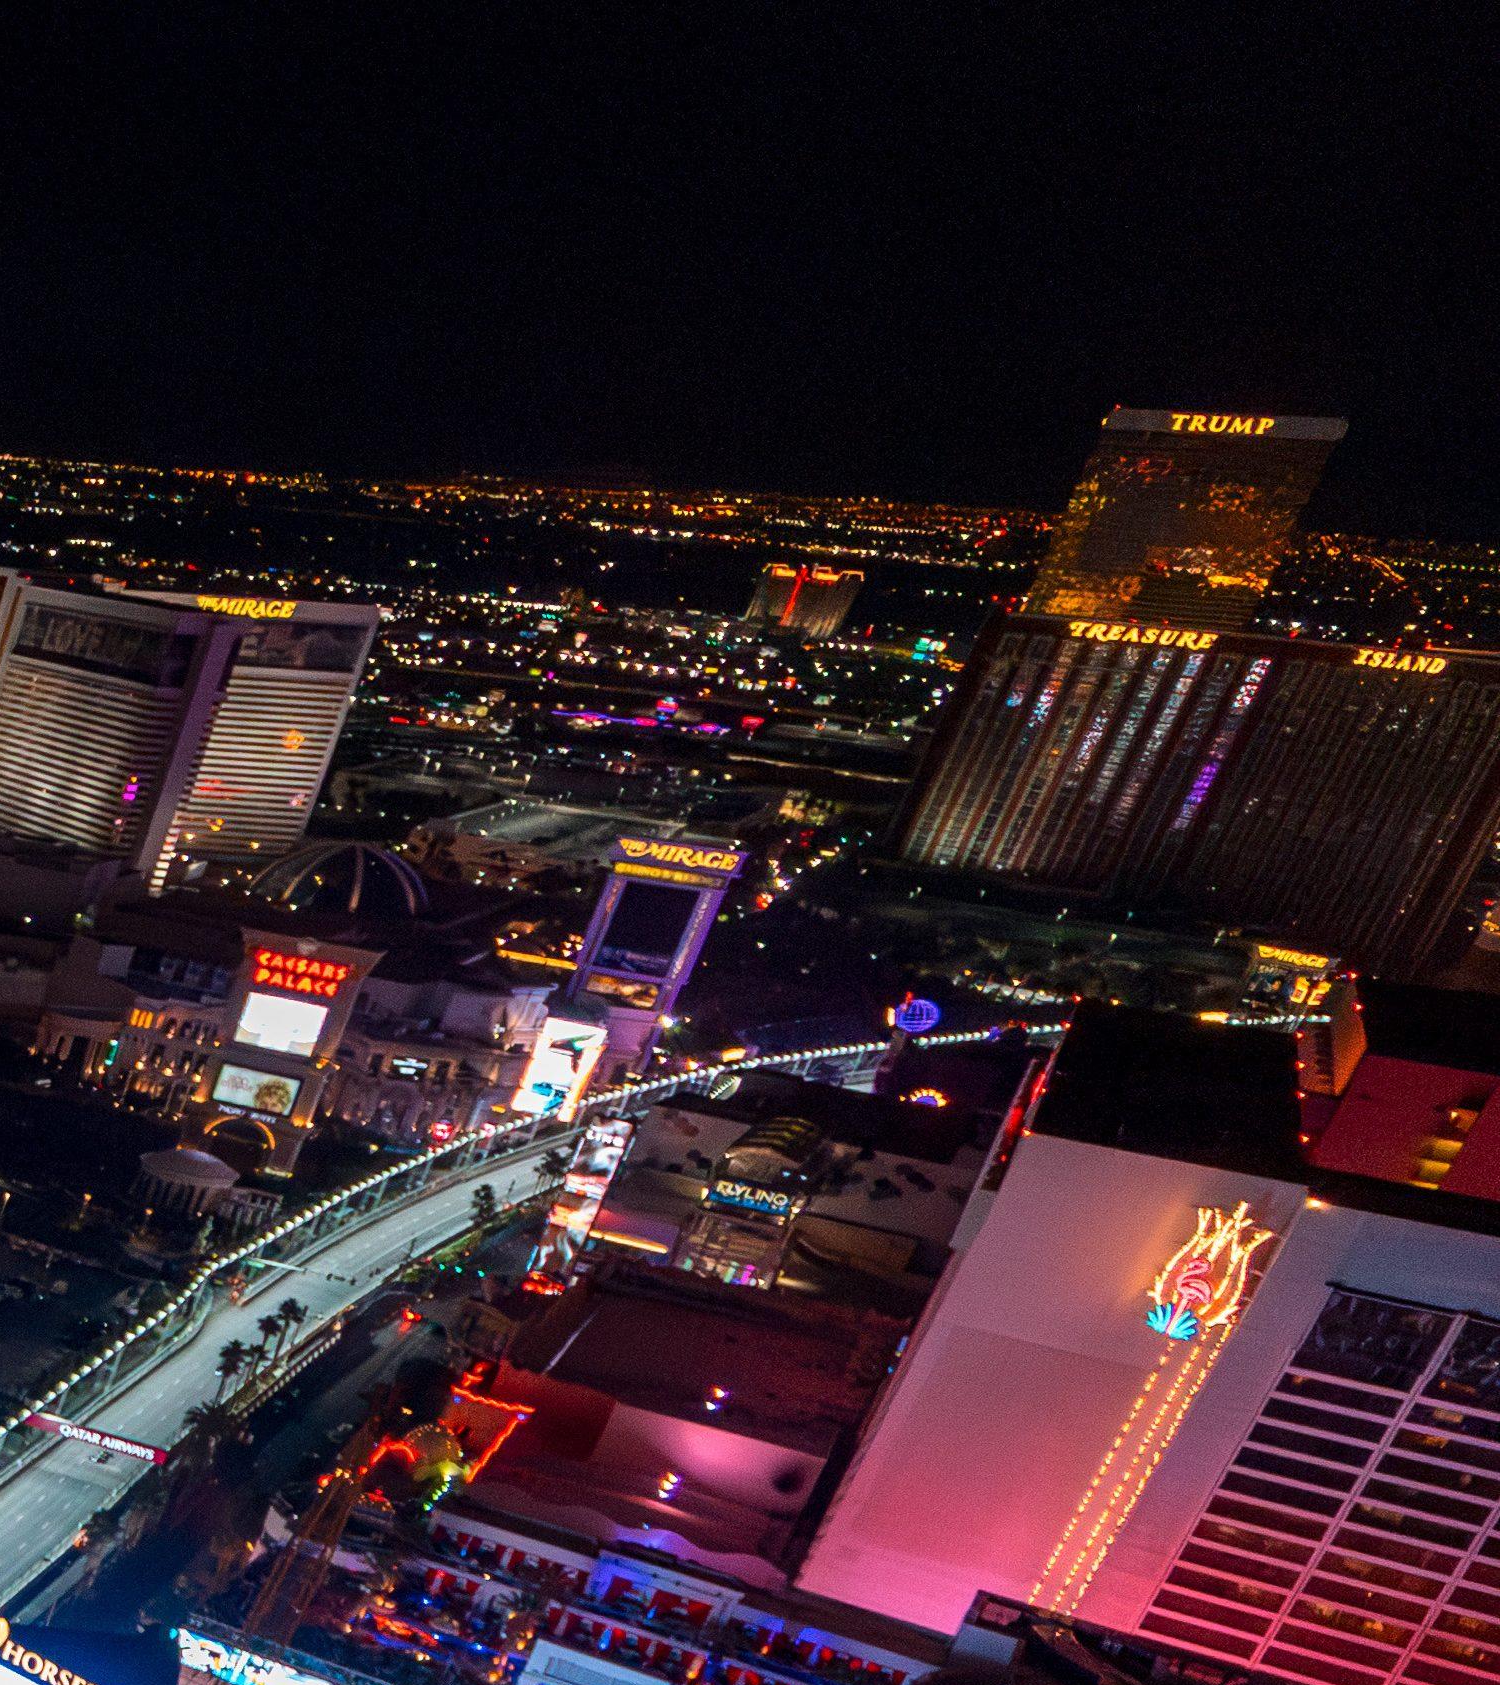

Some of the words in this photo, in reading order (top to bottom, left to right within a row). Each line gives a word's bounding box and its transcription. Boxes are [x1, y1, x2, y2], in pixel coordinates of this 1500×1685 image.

[1171, 413, 1275, 434] TRUMP
[206, 597, 298, 620] MIRAGE
[1068, 621, 1219, 652] TREASURE
[1353, 648, 1448, 675] ISLAND
[626, 842, 740, 871] MIRAGE
[255, 950, 350, 981] CAESARS
[254, 967, 339, 997] PALACE
[58, 1424, 101, 1446] QATAR
[101, 1436, 156, 1461] AIRWAYS
